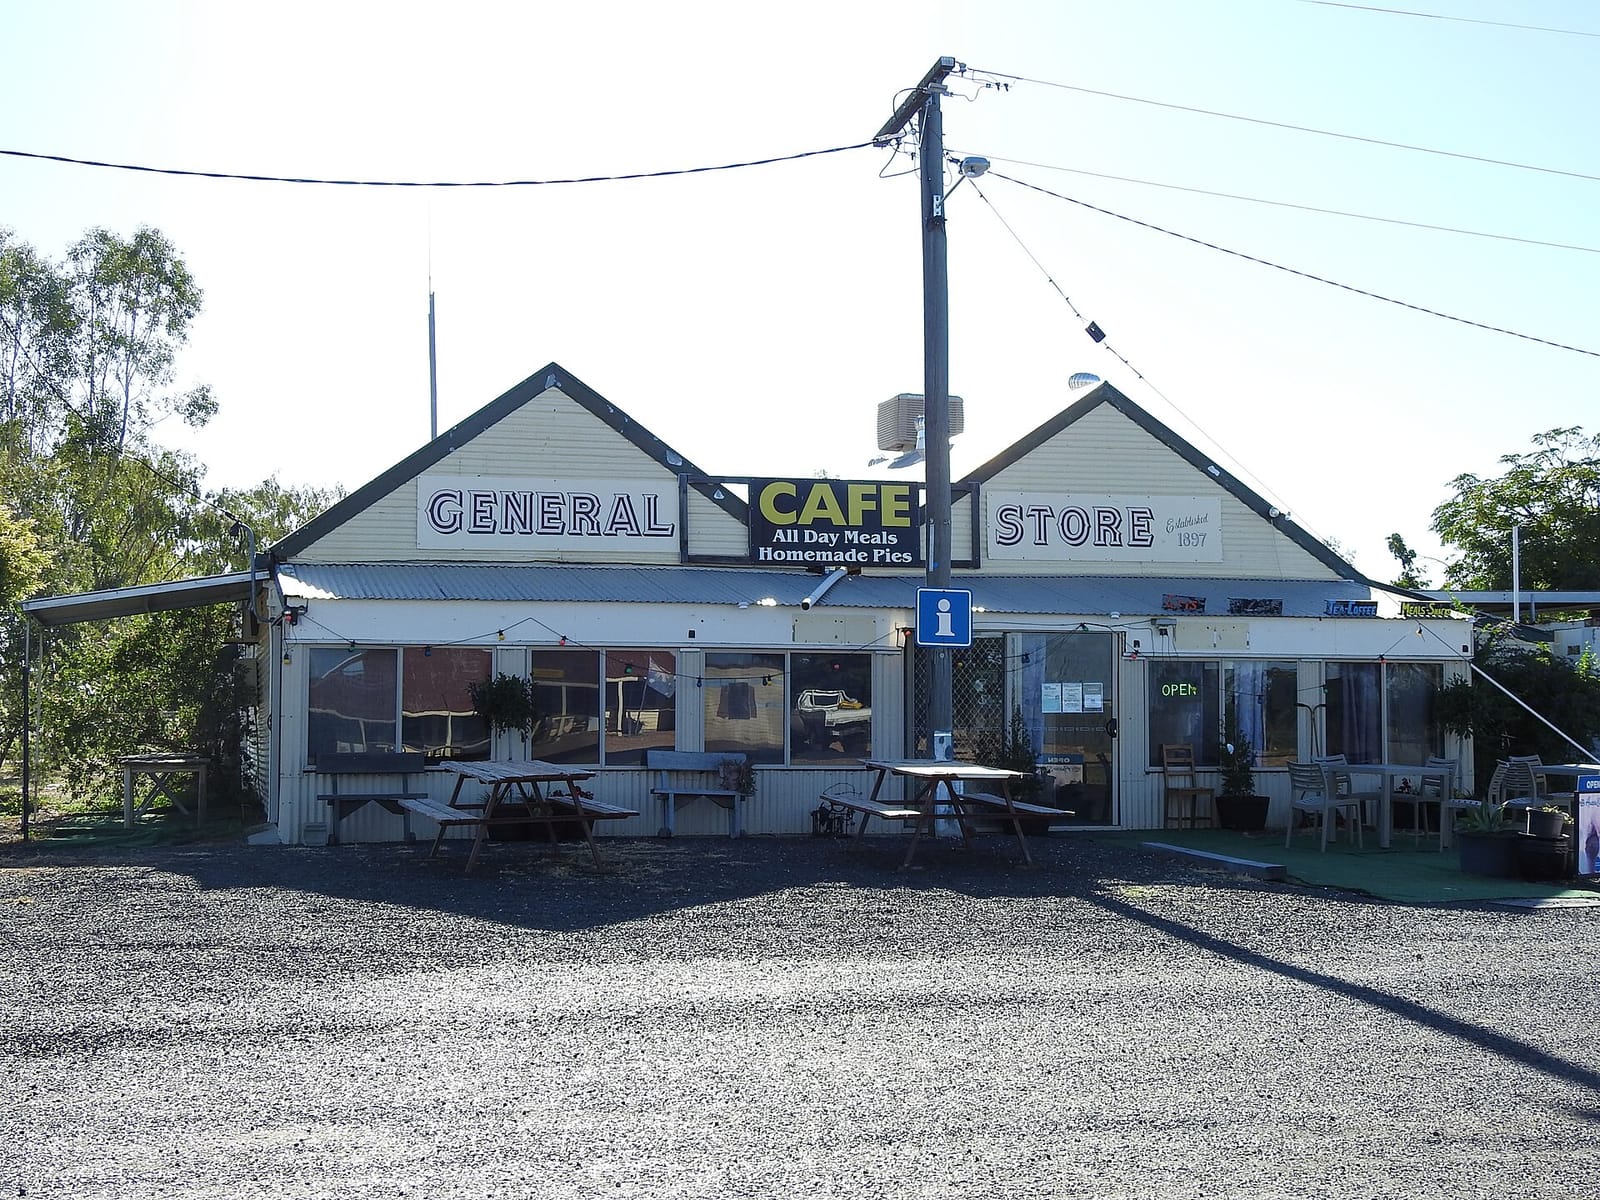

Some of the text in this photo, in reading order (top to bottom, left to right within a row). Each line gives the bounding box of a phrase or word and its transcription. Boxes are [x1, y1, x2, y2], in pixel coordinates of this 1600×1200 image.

[425, 489, 675, 537] GENERAL
[759, 481, 911, 527] CAFE
[995, 504, 1154, 547] STORE
[1165, 513, 1209, 533] Established
[772, 529, 898, 547] All Day Meals
[1177, 532, 1207, 547] 1897
[758, 547, 913, 563] Homemade Pies
